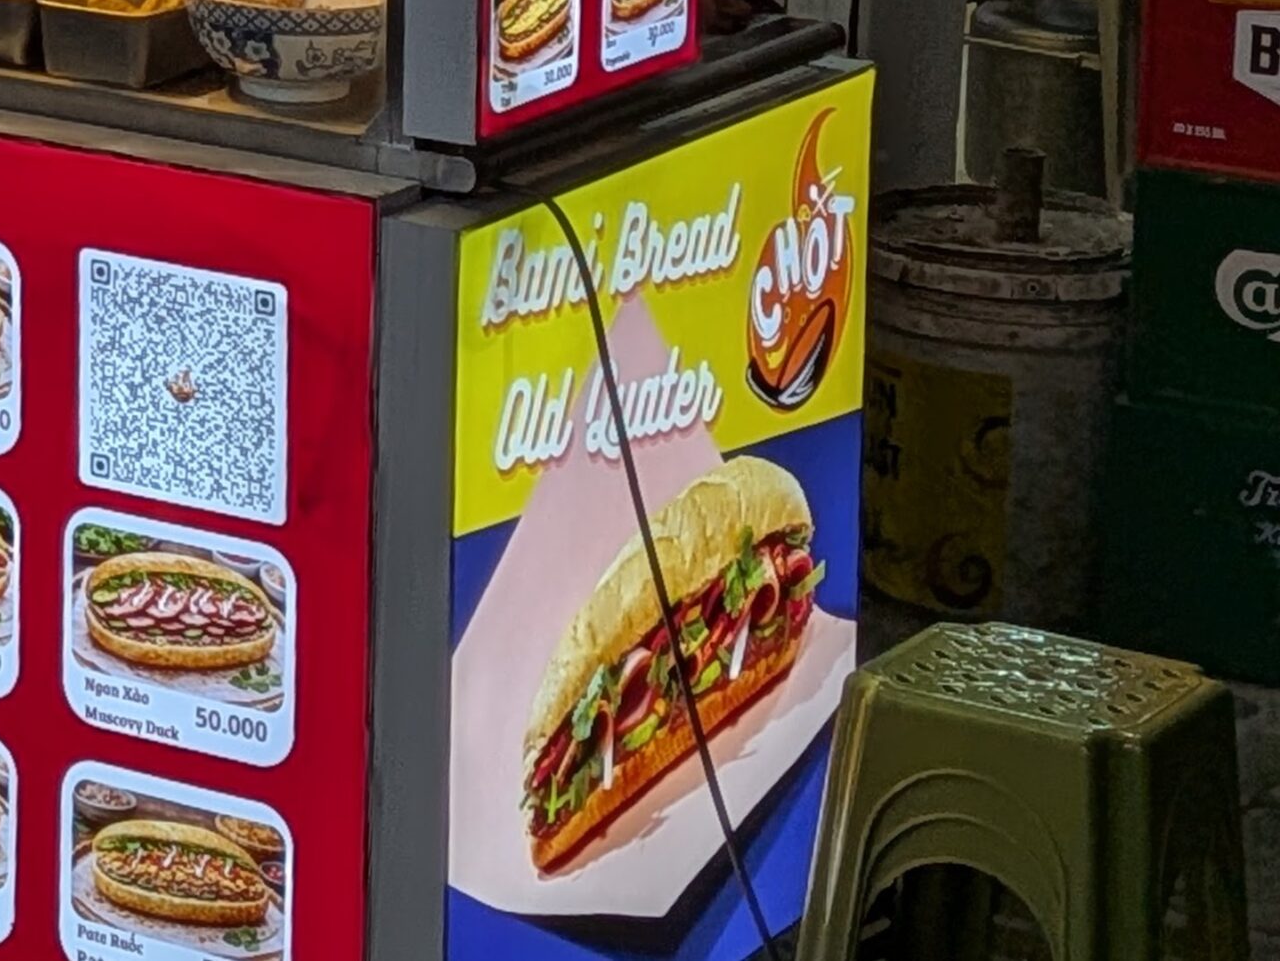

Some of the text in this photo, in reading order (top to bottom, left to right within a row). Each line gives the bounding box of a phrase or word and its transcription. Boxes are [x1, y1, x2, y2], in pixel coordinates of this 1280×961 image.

[611, 182, 742, 295] Bread
[494, 368, 574, 472] Old
[84, 676, 150, 706] Ngan Xào
[84, 704, 180, 741] Muscovy Duck
[194, 706, 268, 742] 50.000
[77, 923, 107, 945] Pate
